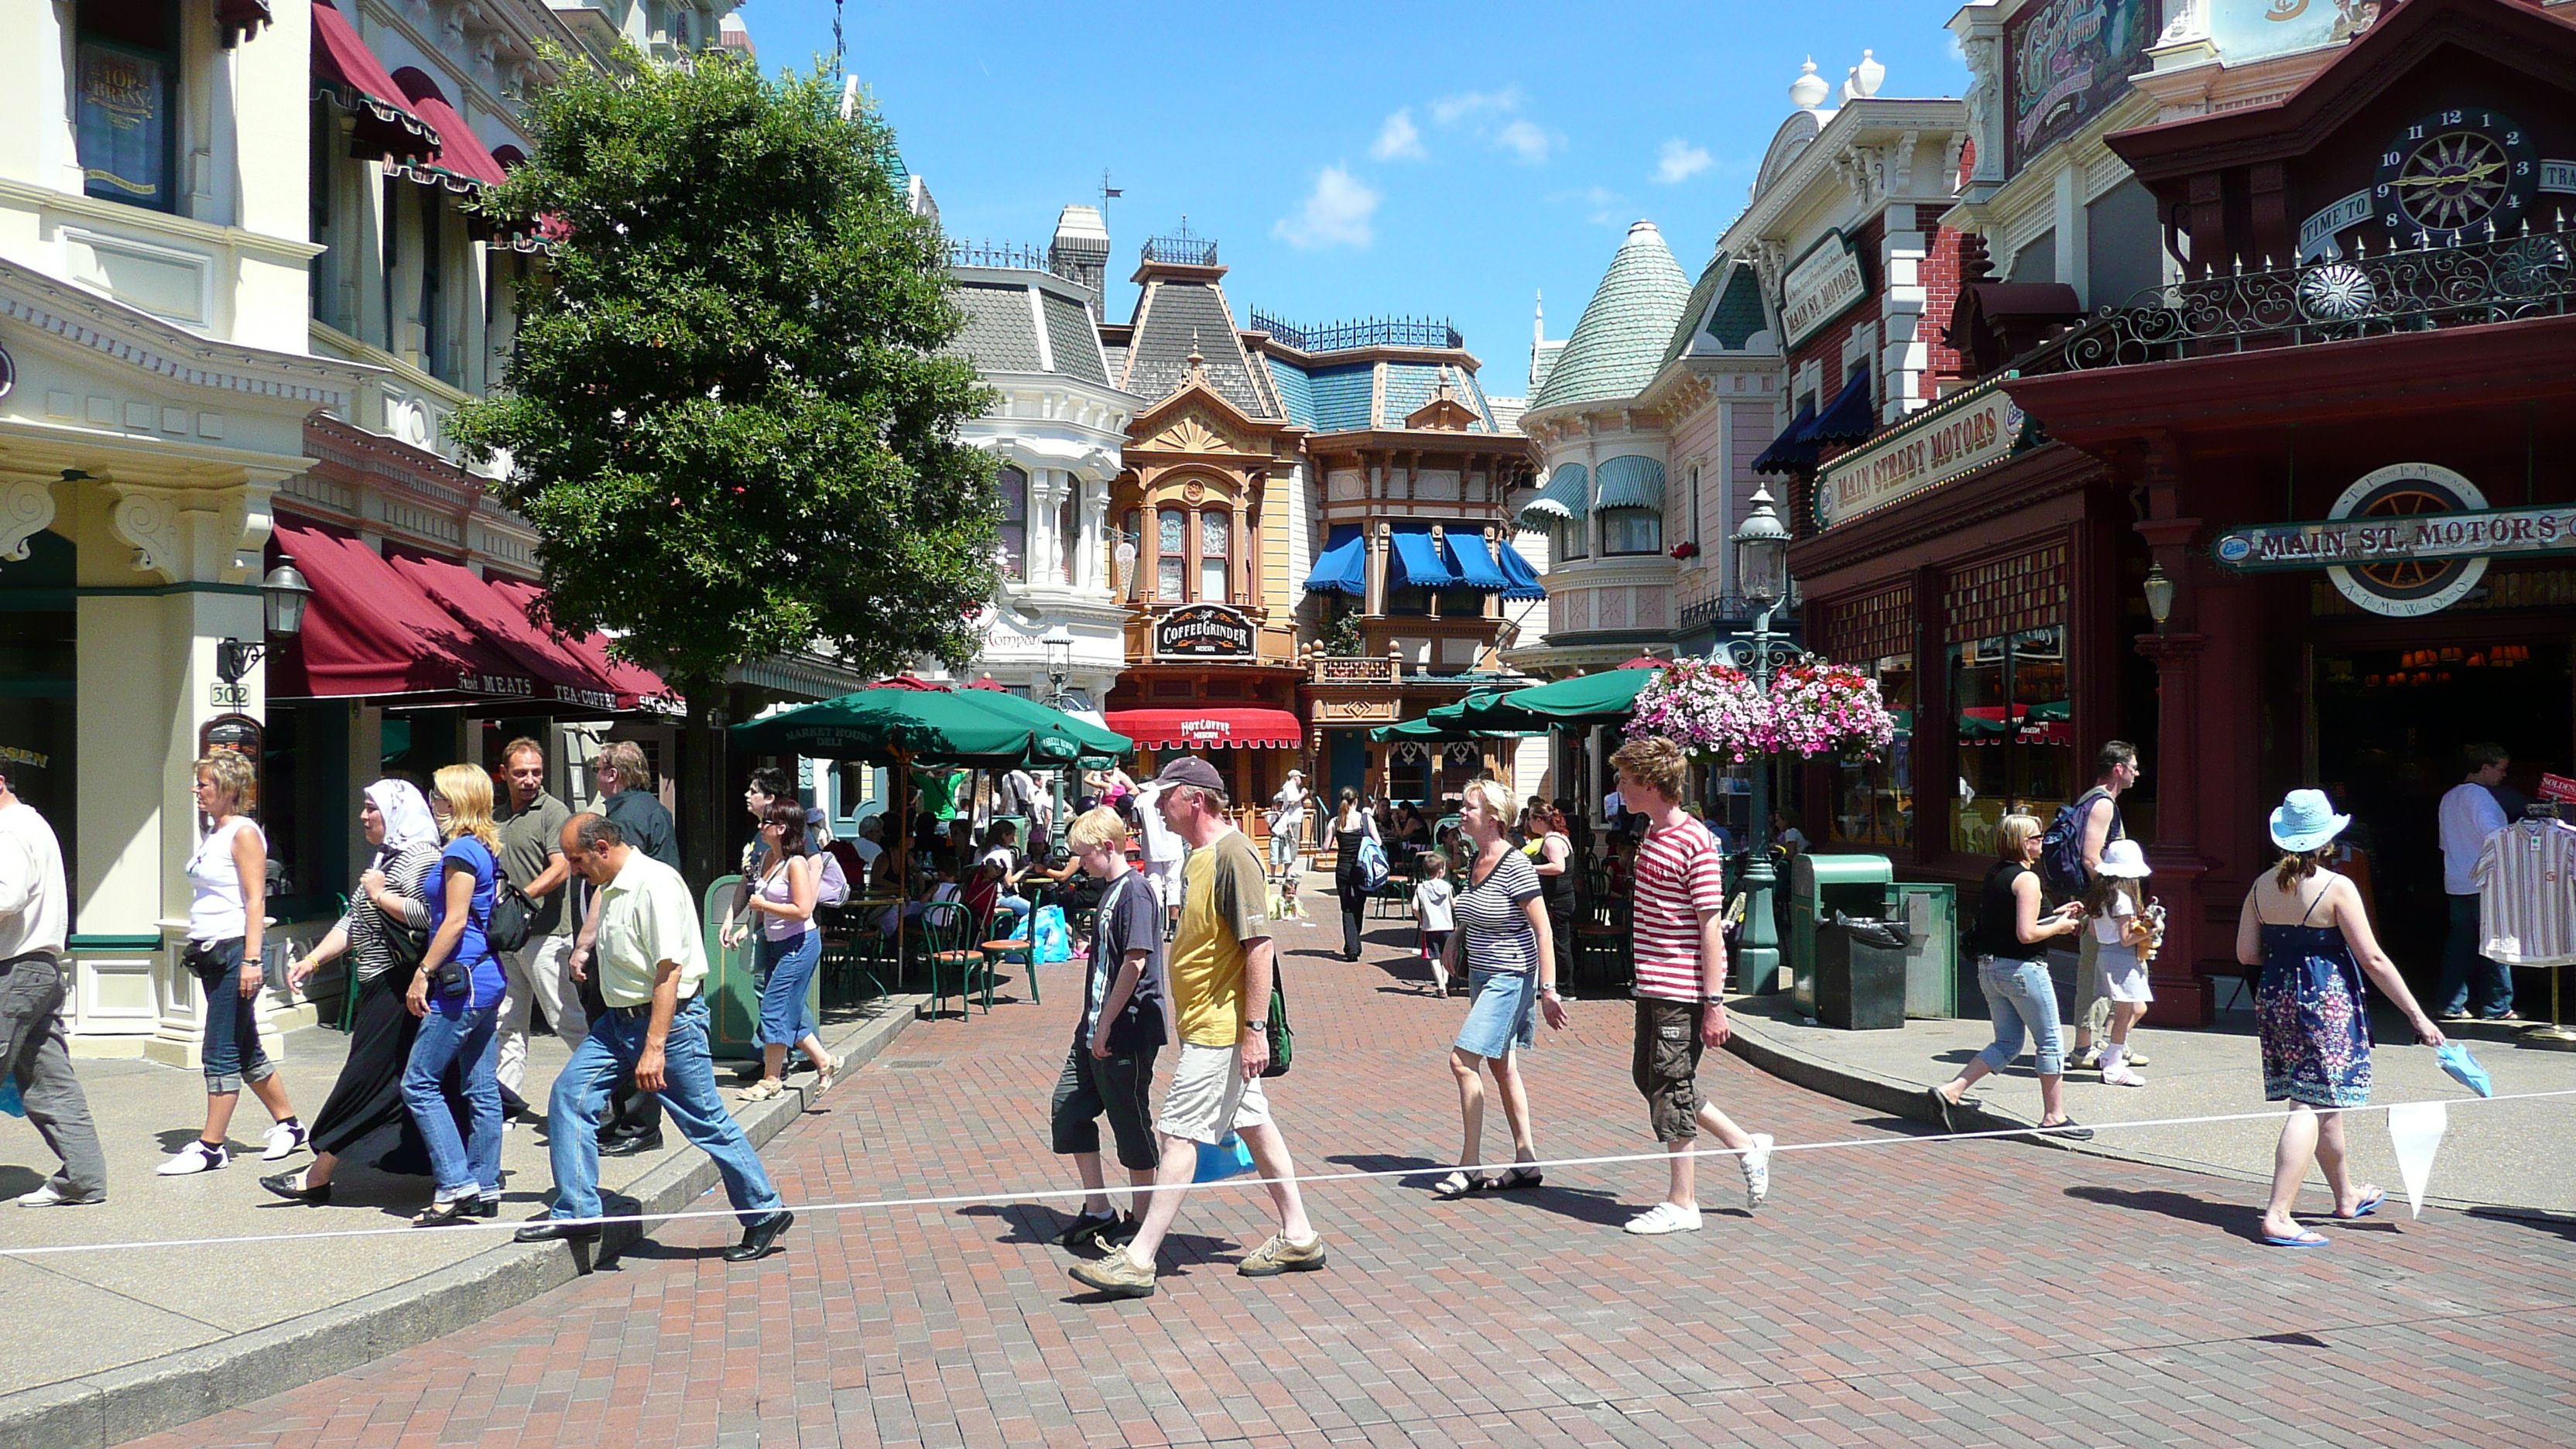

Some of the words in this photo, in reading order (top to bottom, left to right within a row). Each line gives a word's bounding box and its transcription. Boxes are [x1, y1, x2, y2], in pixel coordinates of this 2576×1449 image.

[93, 80, 145, 107] BRASS
[2441, 110, 2462, 125] 12
[2482, 113, 2491, 128] 1
[2407, 125, 2424, 140] 11
[2506, 131, 2520, 146] 2
[2381, 151, 2400, 167] 10
[2516, 160, 2530, 176] 3
[2376, 183, 2389, 198] 9
[2506, 194, 2521, 209] 4
[2303, 207, 2341, 242] TIME
[2345, 197, 2365, 219] TO
[2386, 213, 2398, 227] 8
[2410, 231, 2422, 246] 7
[1786, 303, 1810, 337] MAIN
[1820, 263, 1858, 309] MOTORS
[1838, 465, 1871, 509] MAIN
[1873, 439, 1926, 494] STREET
[1930, 406, 1997, 468] MOTORS
[2260, 530, 2348, 560] MAIN
[2358, 527, 2406, 554] ST.
[2413, 515, 2559, 551] MOTORS
[2222, 540, 2246, 557] Esso
[482, 675, 532, 694] MEATS
[786, 728, 833, 742] MARKET
[817, 737, 842, 746] DELI
